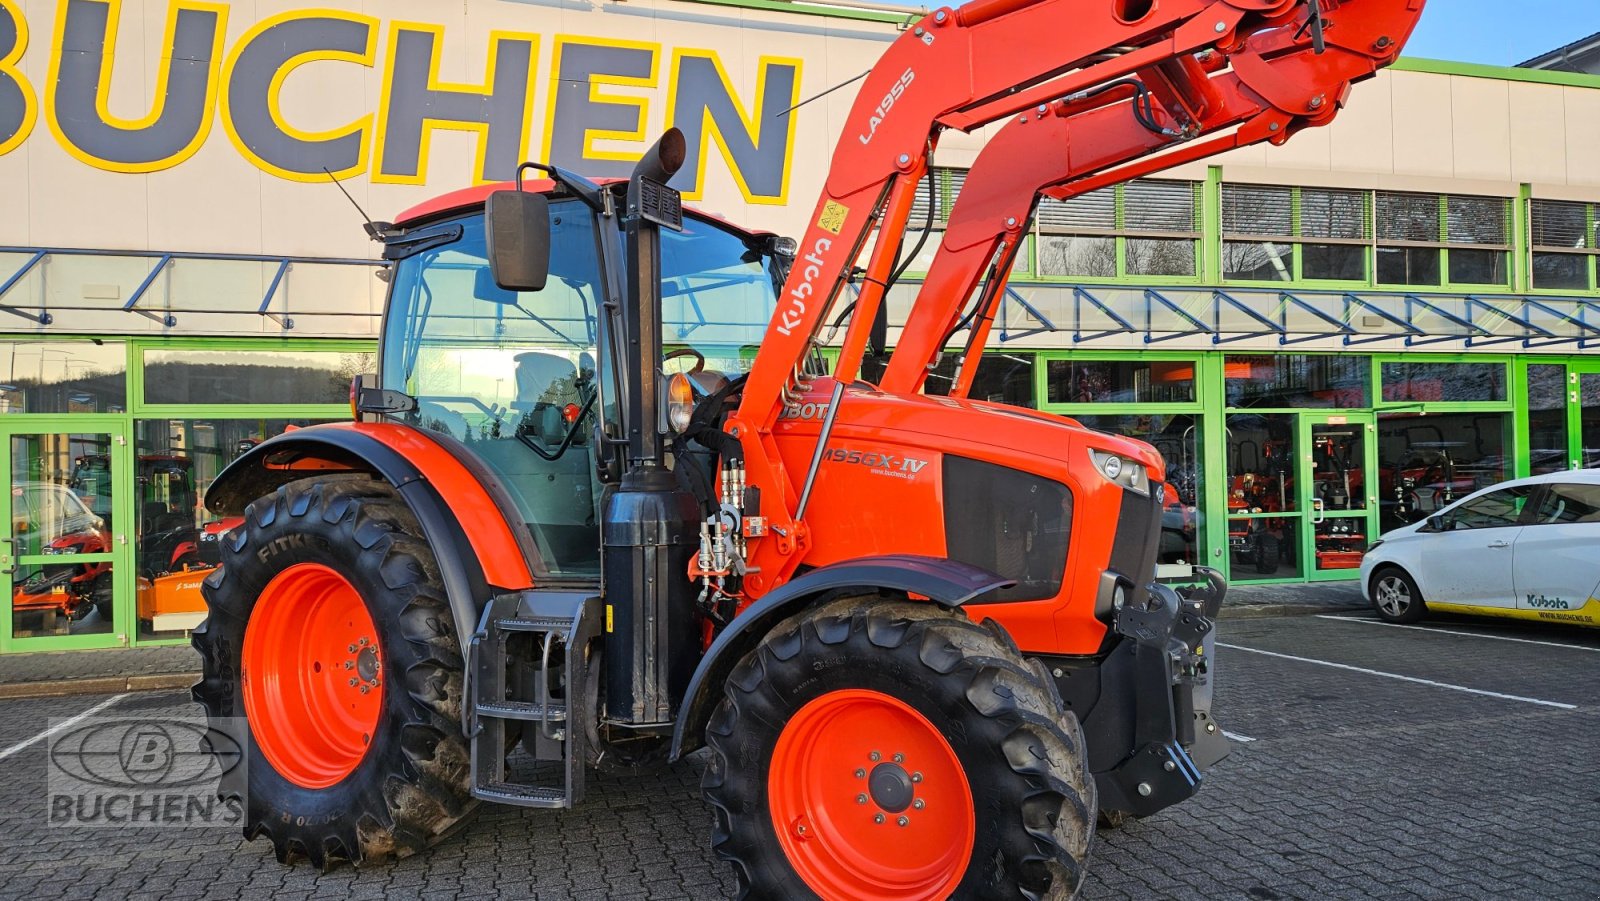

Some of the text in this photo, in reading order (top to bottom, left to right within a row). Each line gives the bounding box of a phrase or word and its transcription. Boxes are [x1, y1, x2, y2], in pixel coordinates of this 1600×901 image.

[0, 0, 803, 206] UCHEN
[859, 67, 915, 145] LA1955
[777, 237, 831, 336] Kubota
[1527, 594, 1568, 609] Kubota
